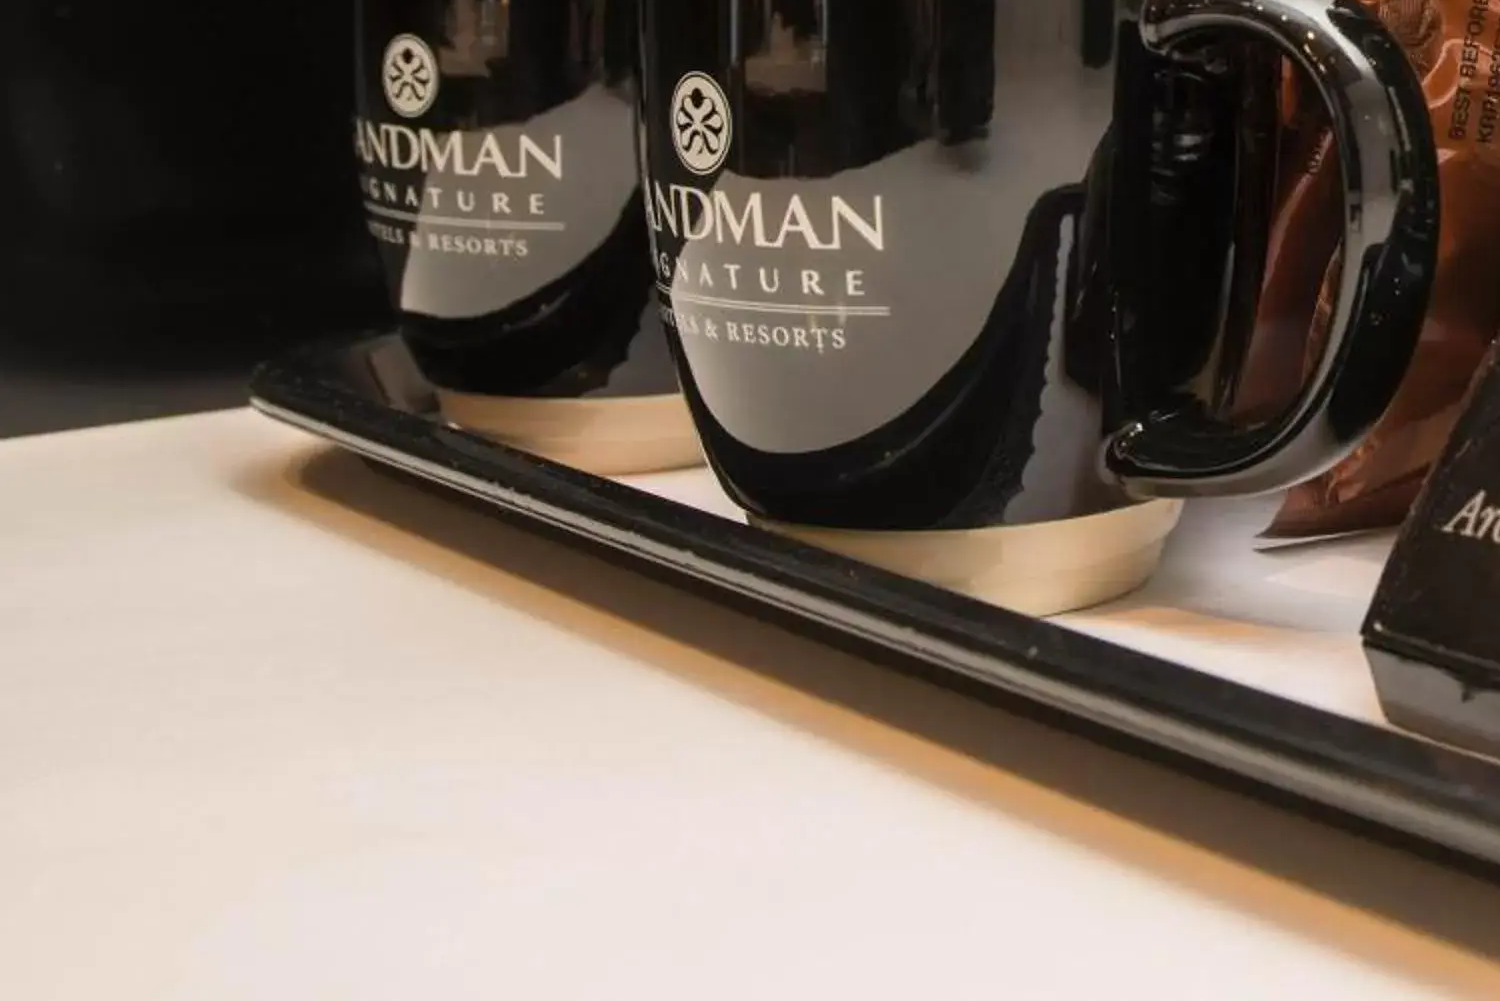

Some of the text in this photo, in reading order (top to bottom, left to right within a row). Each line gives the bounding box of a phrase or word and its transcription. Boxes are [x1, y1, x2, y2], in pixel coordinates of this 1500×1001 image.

[1449, 86, 1471, 140] BEST
[428, 232, 528, 256] RESORTS
[727, 320, 847, 350] RESORTS
